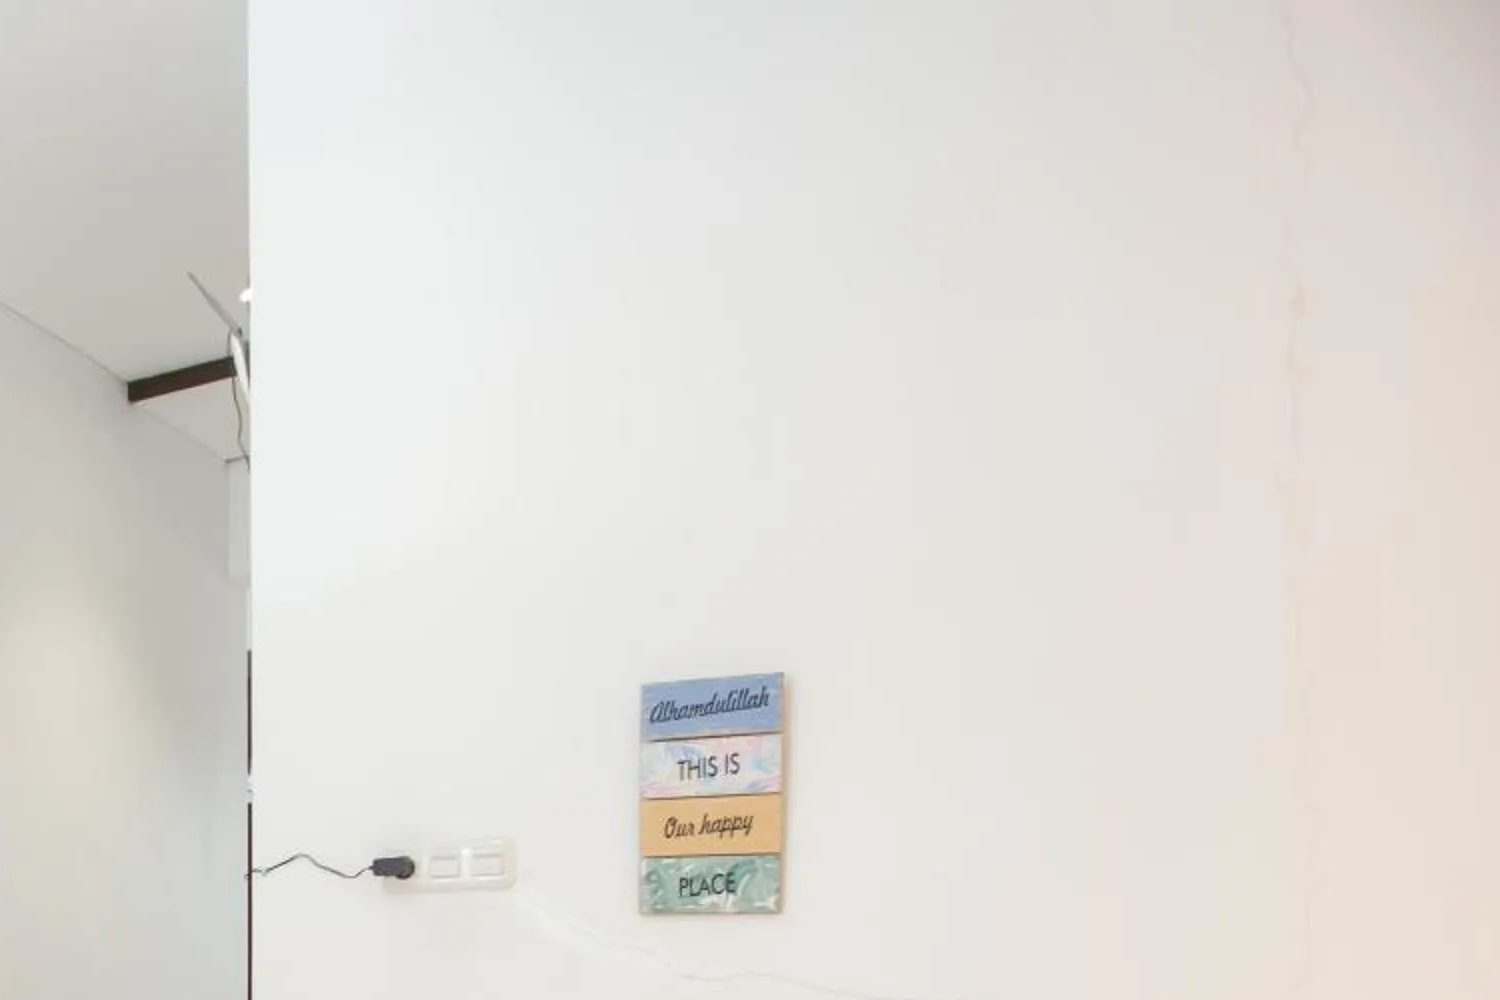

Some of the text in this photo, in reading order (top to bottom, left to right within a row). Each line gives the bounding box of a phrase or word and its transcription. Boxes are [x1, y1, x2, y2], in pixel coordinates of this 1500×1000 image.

[650, 686, 769, 723] Alhamdulillah
[677, 753, 741, 781] THIS IS
[664, 813, 754, 839] Our happy
[679, 872, 736, 897] PLACE
